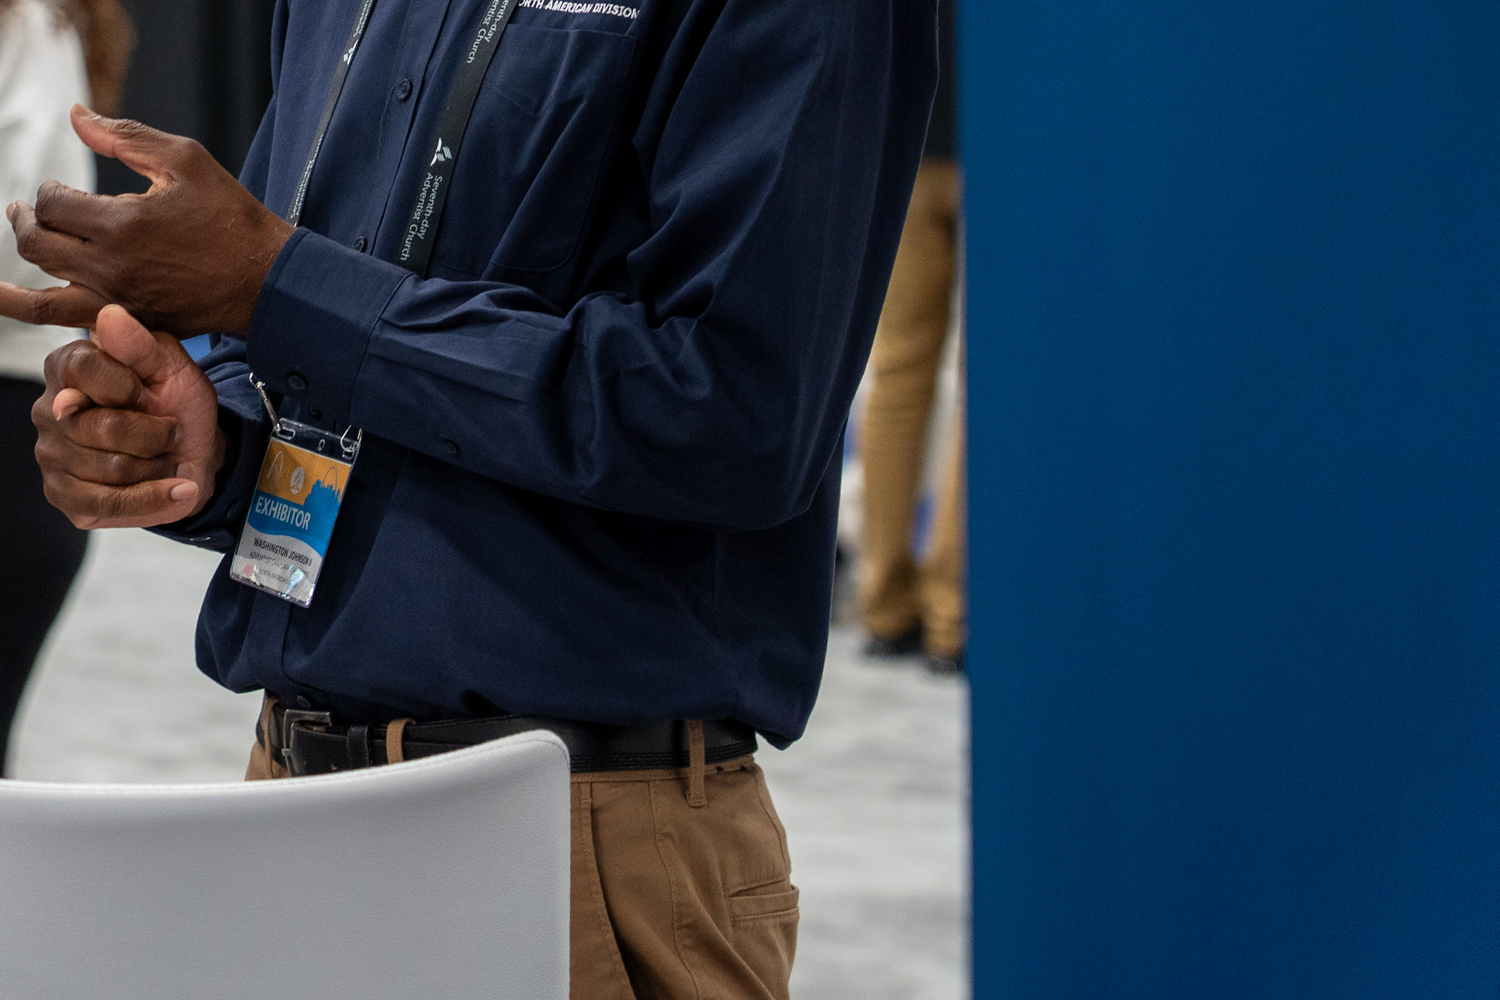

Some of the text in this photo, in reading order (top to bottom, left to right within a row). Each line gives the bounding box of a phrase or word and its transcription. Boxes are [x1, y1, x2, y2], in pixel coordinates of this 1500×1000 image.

[544, 0, 593, 14] AMERICAN
[592, 2, 640, 20] DIVISION
[466, 28, 487, 64] Church
[399, 171, 434, 261] Adventist Church
[416, 174, 443, 240] Seventh-day
[254, 495, 312, 531] EXHIBITOR
[253, 537, 289, 558] WASHINGTON
